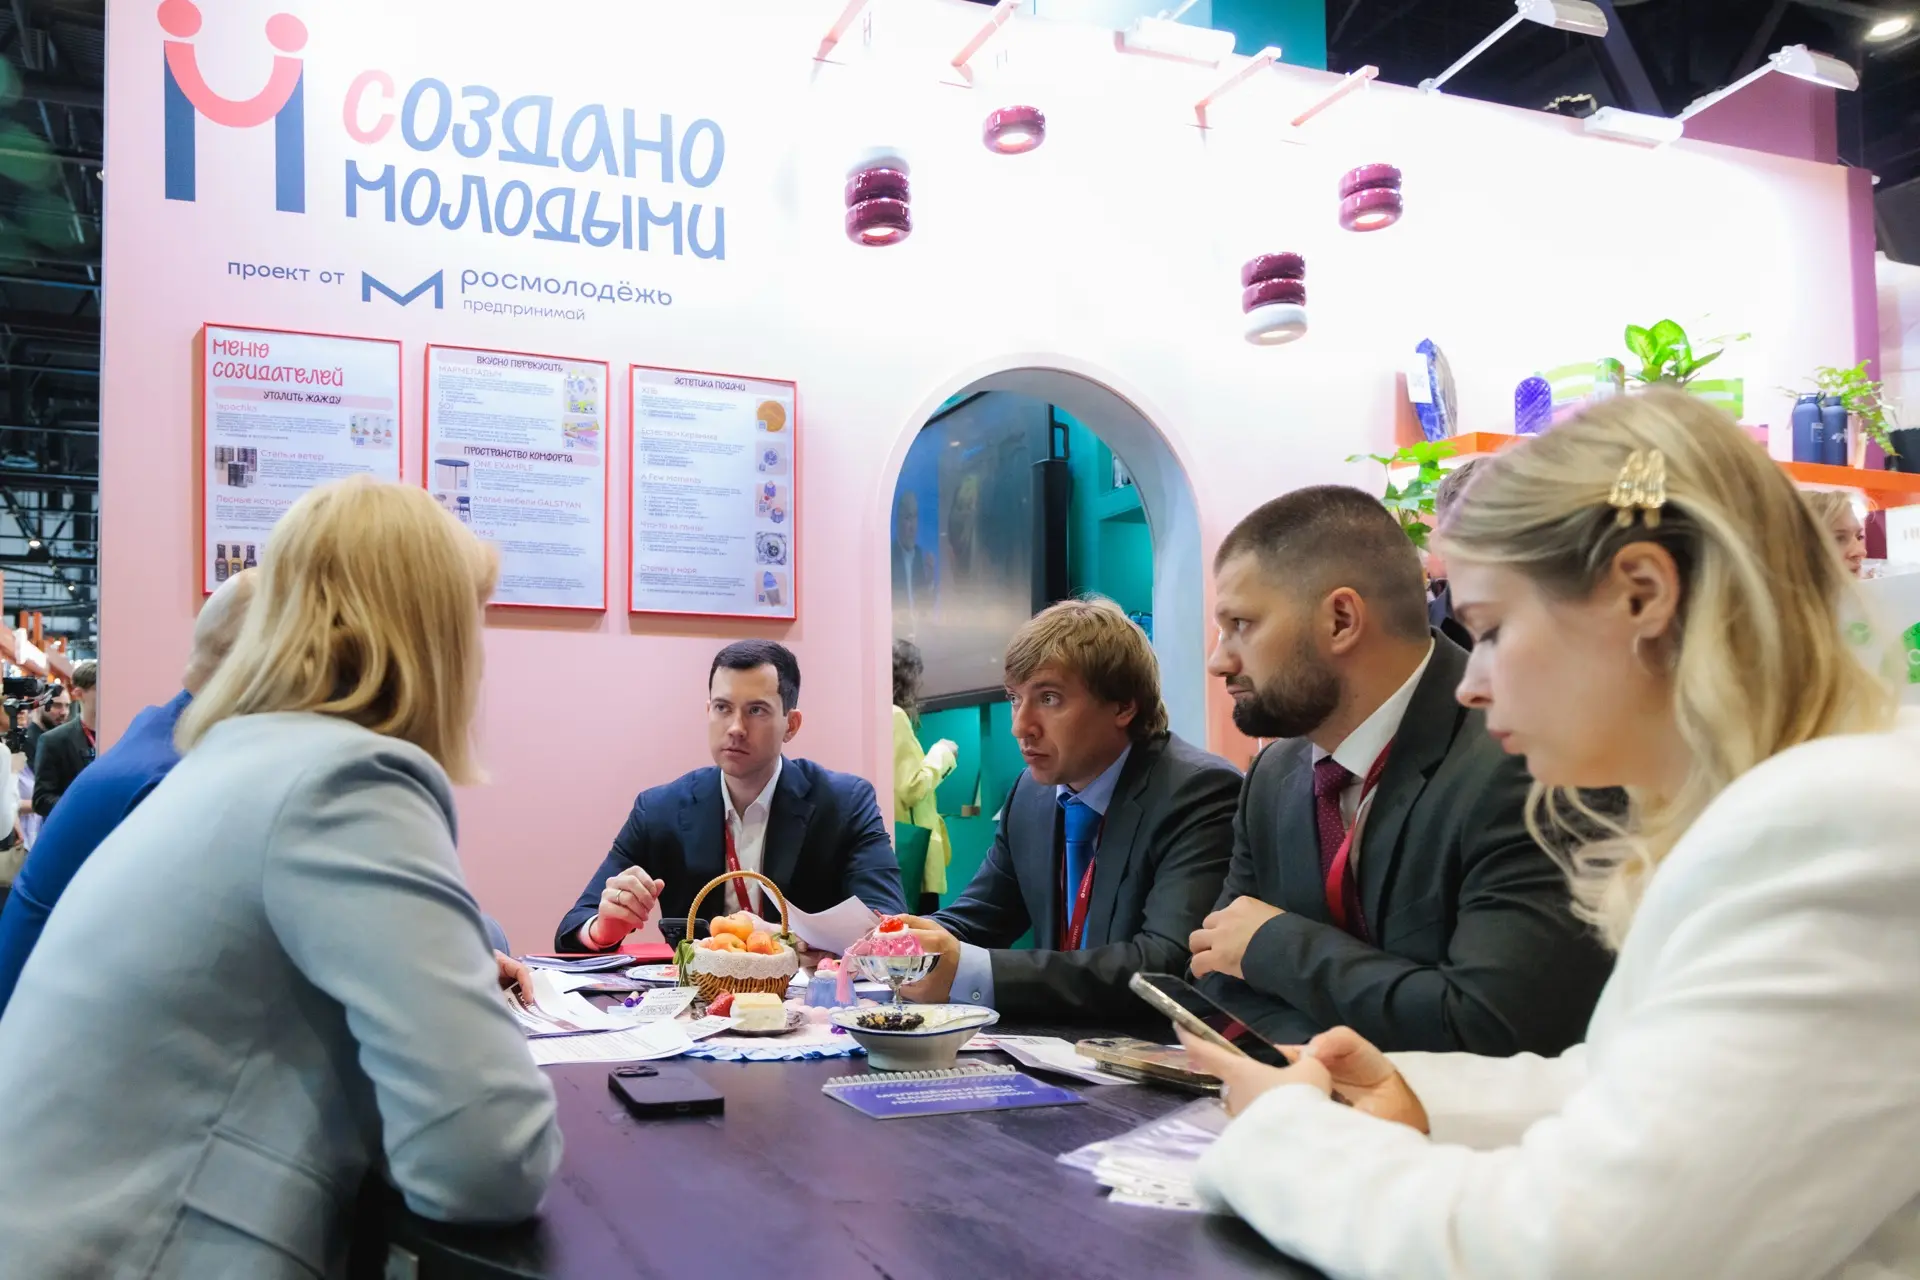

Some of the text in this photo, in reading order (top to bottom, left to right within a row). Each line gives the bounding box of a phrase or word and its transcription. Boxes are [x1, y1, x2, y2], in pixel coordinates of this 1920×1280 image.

[227, 261, 345, 285] проект от
[460, 267, 673, 306] росмолодёжь
[463, 297, 586, 321] предпринимай
[537, 500, 581, 509] GALSTYAN
